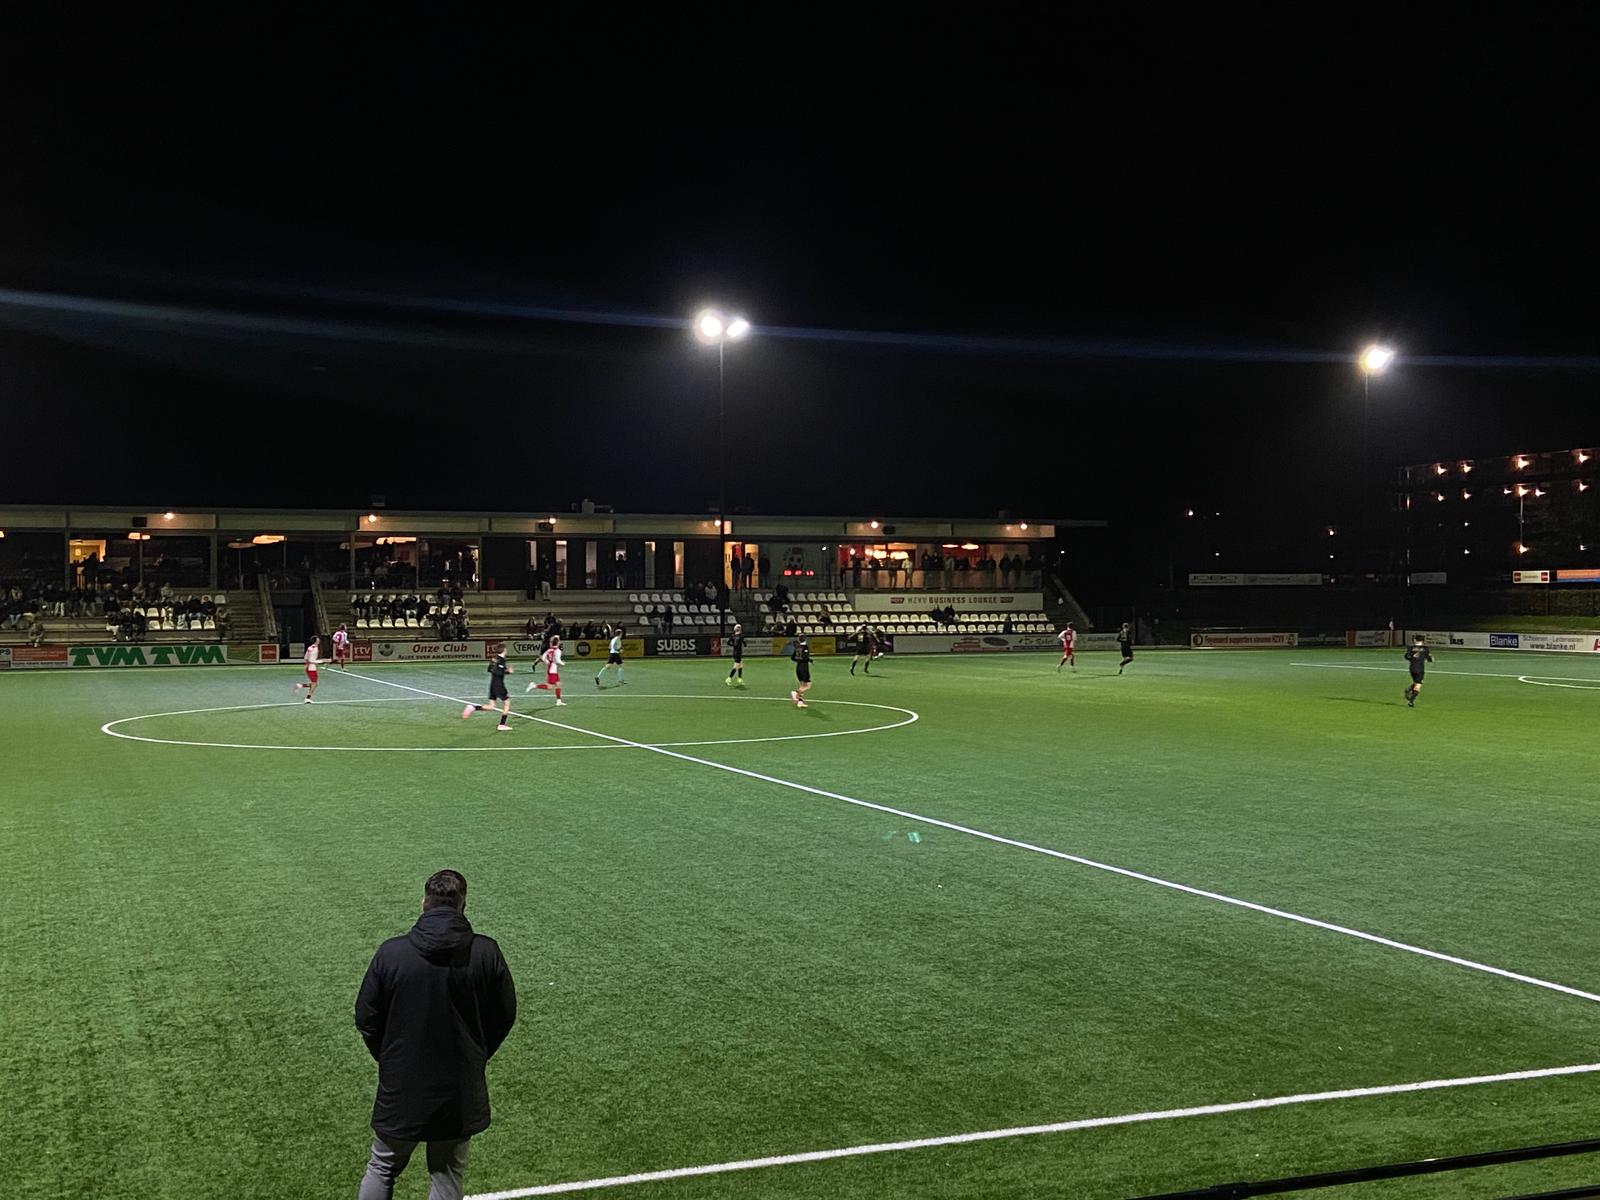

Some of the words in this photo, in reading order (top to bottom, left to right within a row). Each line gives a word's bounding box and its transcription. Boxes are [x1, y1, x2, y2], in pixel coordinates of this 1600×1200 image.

[928, 596, 966, 604] BUSINESS
[656, 639, 696, 651] SUBBS
[1490, 635, 1519, 646] Blanke
[354, 646, 371, 655] rtv
[412, 643, 440, 653] Onze
[443, 643, 467, 652] Club
[1529, 642, 1576, 650] www.blanke.nl
[69, 647, 147, 666] TVM
[150, 645, 226, 665] TVM
